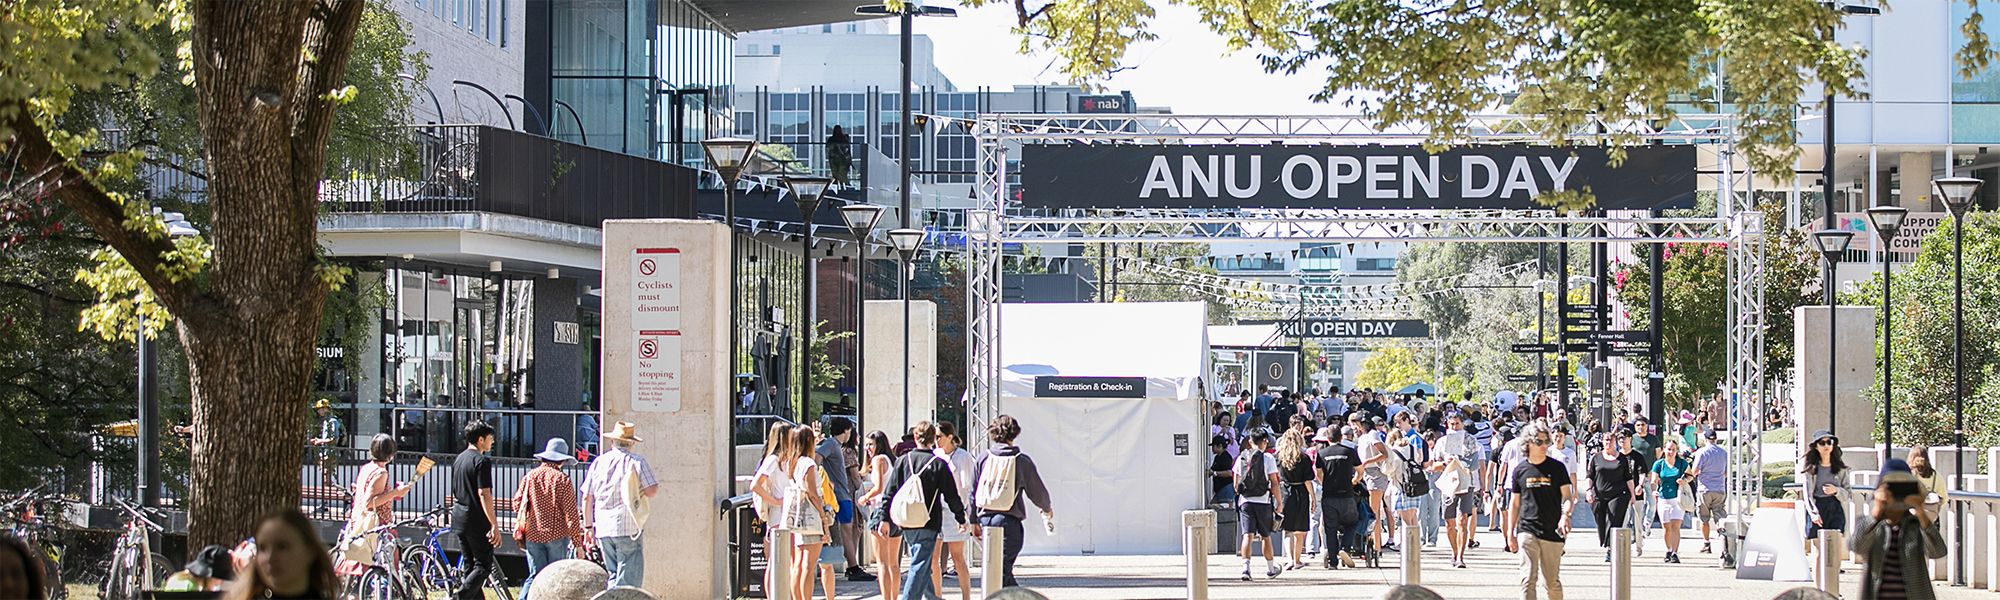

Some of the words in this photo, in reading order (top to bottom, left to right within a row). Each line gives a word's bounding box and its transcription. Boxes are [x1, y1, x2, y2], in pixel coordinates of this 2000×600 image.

[1097, 98, 1120, 109] nab
[1138, 155, 1262, 199] ANU
[1281, 154, 1440, 200] OPEN
[1461, 155, 1579, 200] DAY
[1902, 218, 1941, 227] UPPO
[637, 281, 673, 291] Cyclists
[637, 304, 679, 312] dismount
[1310, 321, 1357, 336] OPEN
[1361, 321, 1396, 336] DAY
[639, 361, 652, 369] No
[638, 370, 674, 380] stopping
[1048, 382, 1092, 391] Registration
[1100, 382, 1133, 391] Check-in
